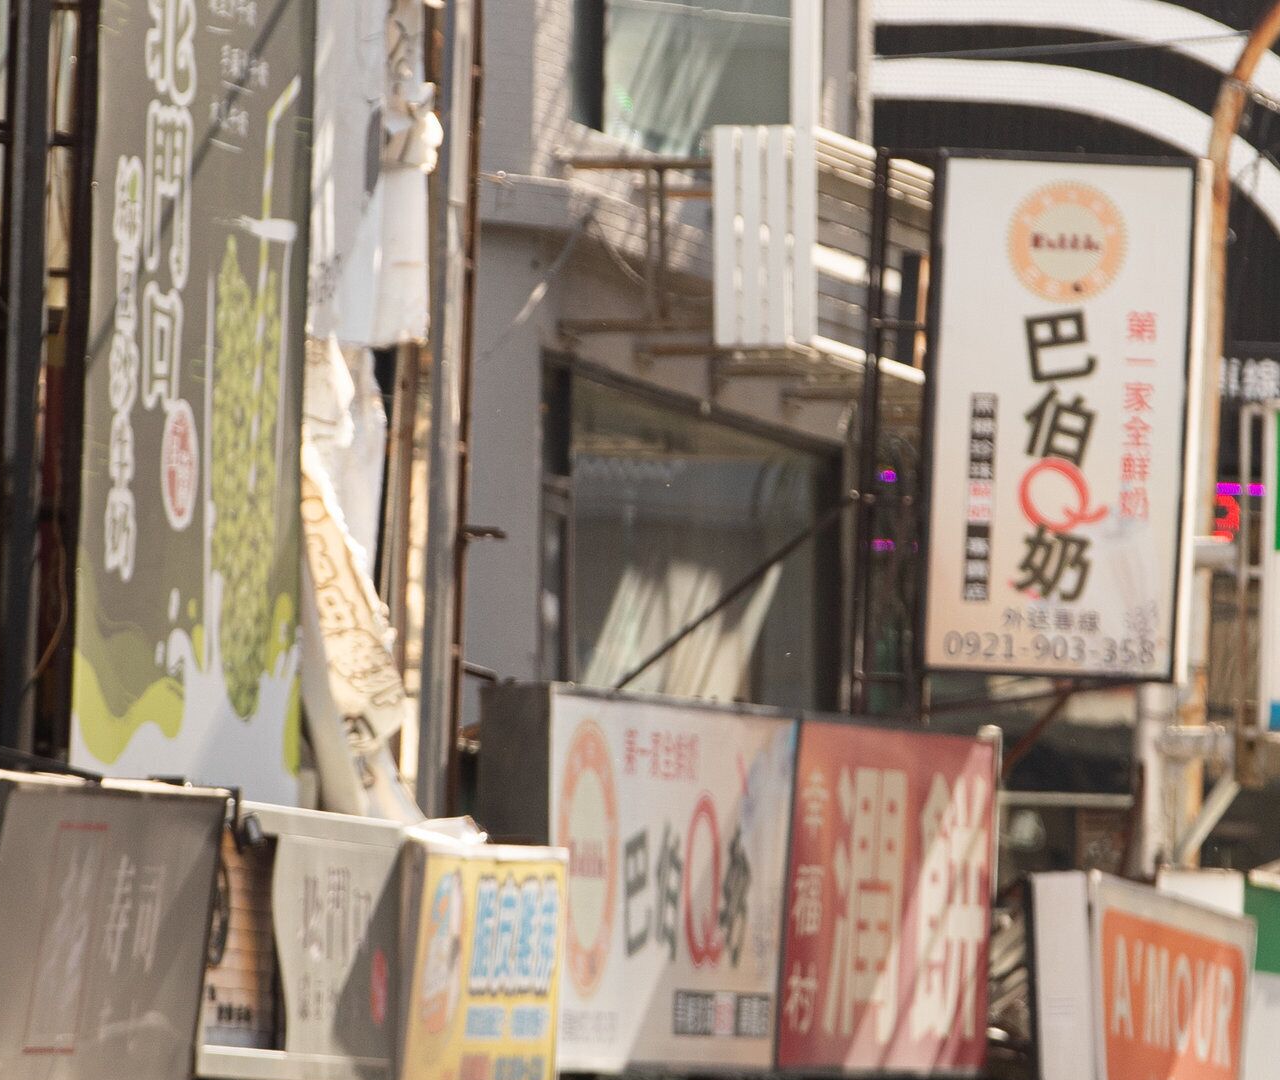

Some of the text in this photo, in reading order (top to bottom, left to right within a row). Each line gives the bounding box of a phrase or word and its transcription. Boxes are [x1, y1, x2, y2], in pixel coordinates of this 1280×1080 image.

[1014, 309, 1109, 603] 巴伯Q奶
[943, 631, 1157, 668] 0921-903-358
[622, 790, 751, 970] 巴伯Q奶
